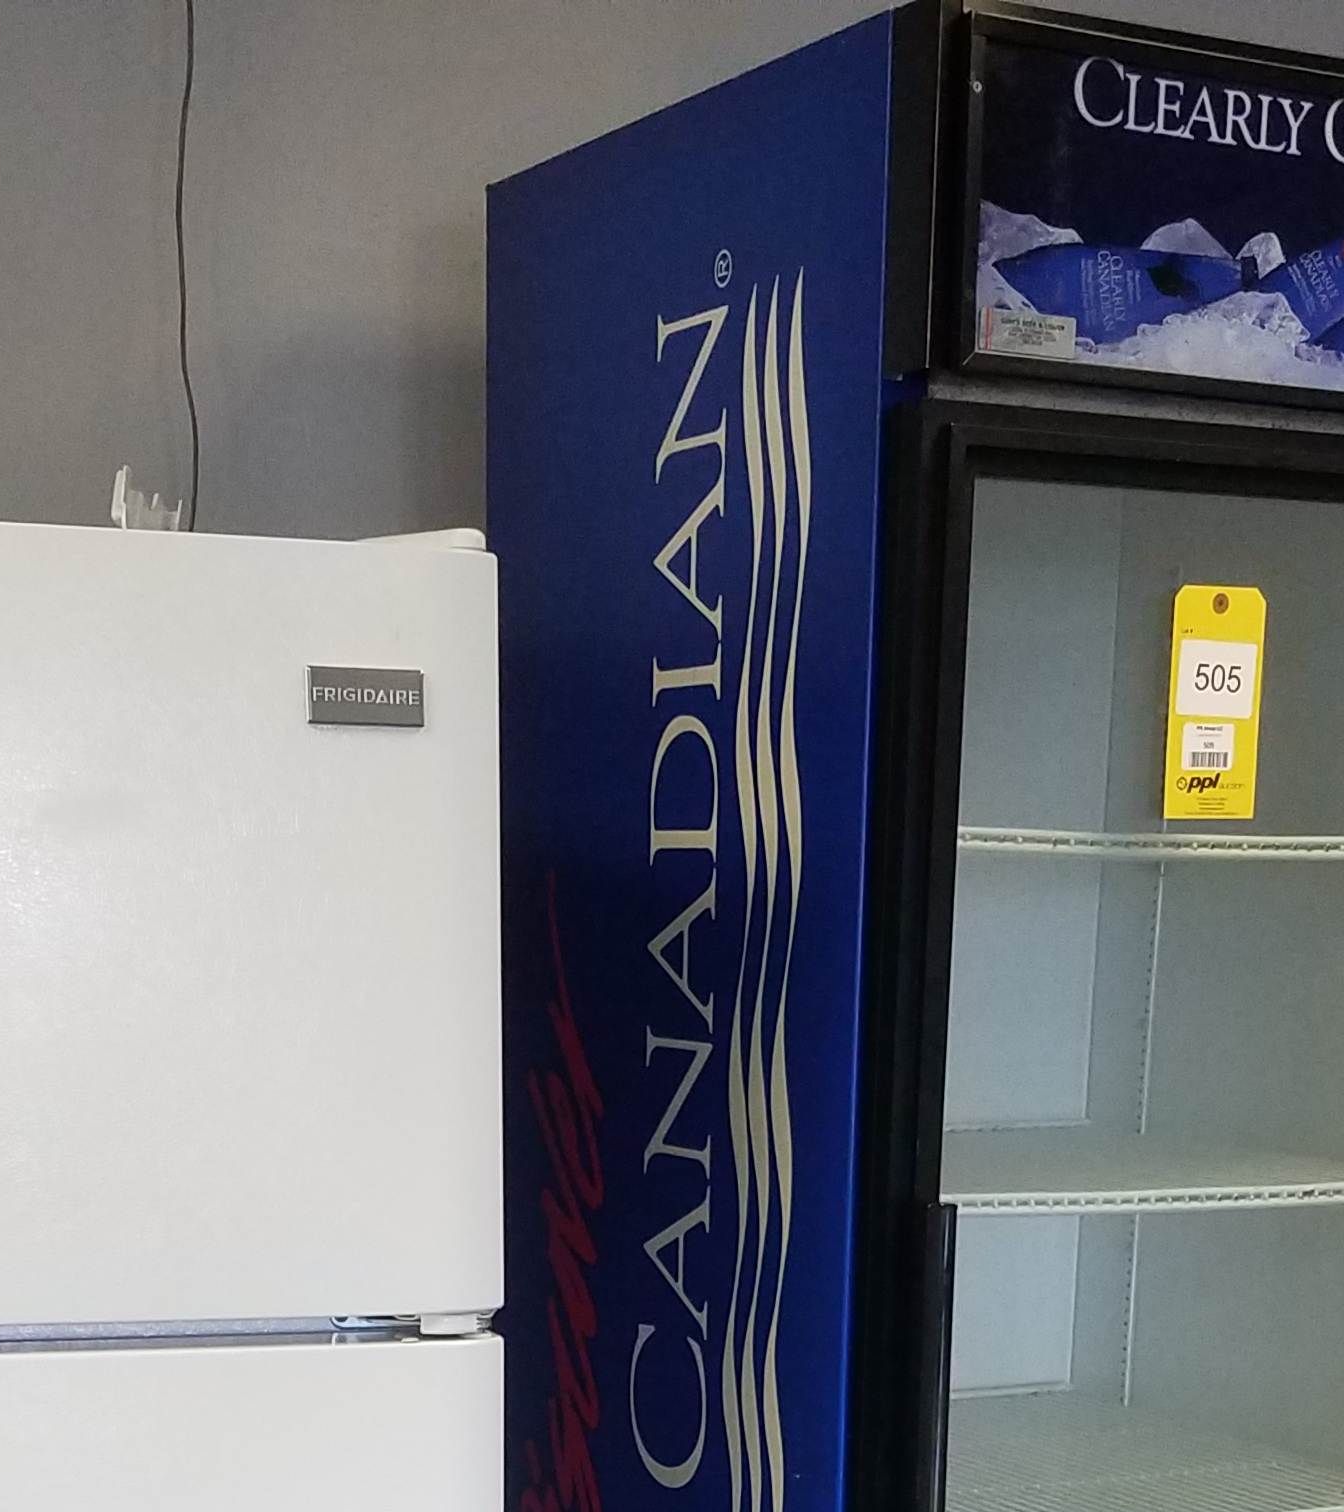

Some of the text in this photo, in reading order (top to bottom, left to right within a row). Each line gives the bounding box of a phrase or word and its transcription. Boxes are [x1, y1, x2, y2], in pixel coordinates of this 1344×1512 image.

[1073, 55, 1315, 157] CLEARLY
[1194, 663, 1242, 693] 505
[312, 686, 420, 706] FRIGIDAIRE
[1187, 773, 1221, 793] ppl
